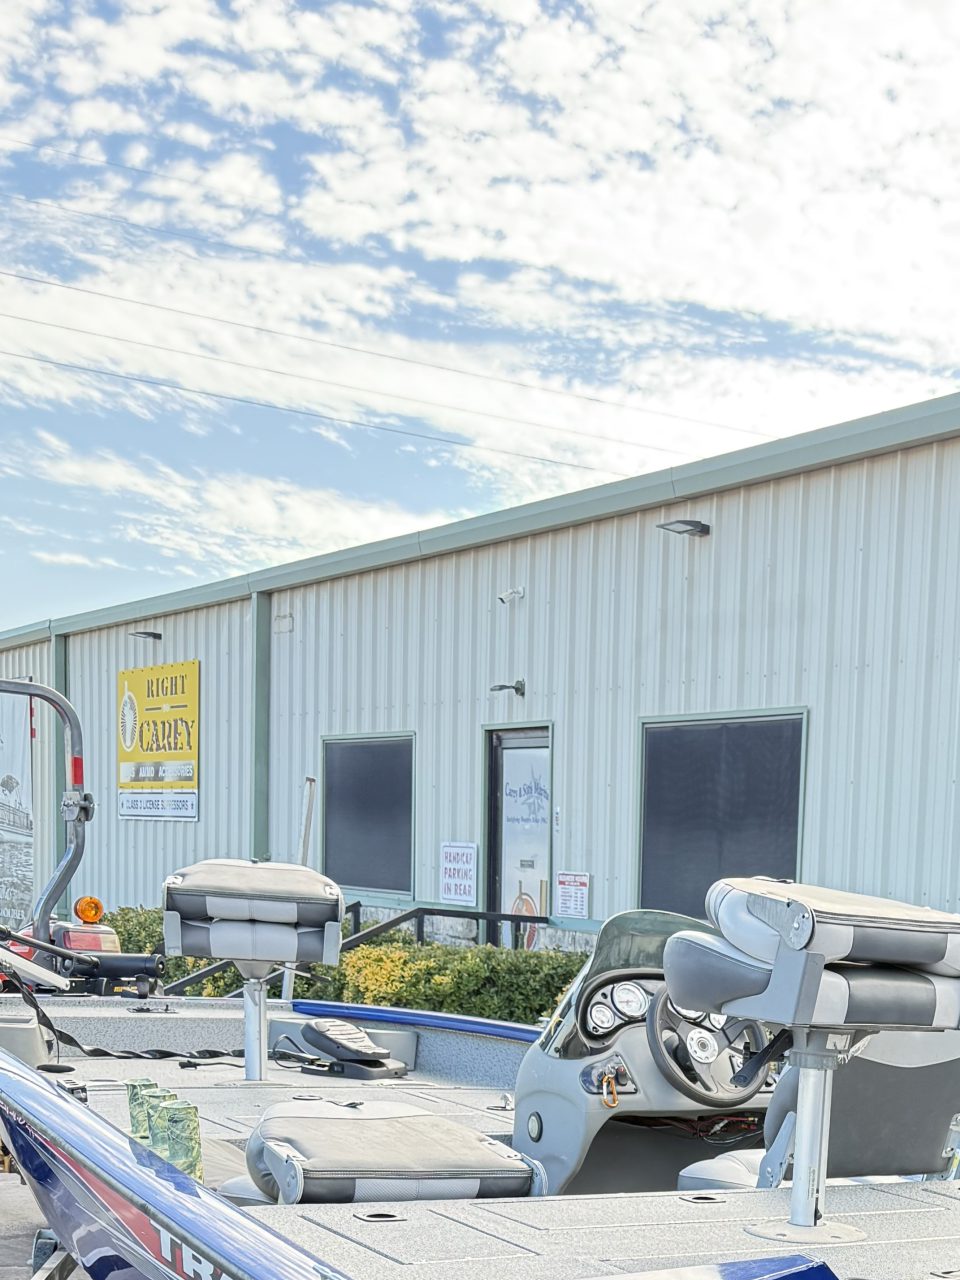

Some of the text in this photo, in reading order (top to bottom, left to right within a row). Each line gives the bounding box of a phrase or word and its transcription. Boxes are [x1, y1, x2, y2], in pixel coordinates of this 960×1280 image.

[146, 674, 187, 698] RIGHT
[138, 717, 195, 752] CAREY
[444, 851, 473, 865] HANDICAP
[444, 867, 473, 881] PARKING
[444, 882, 473, 897] IN REAR
